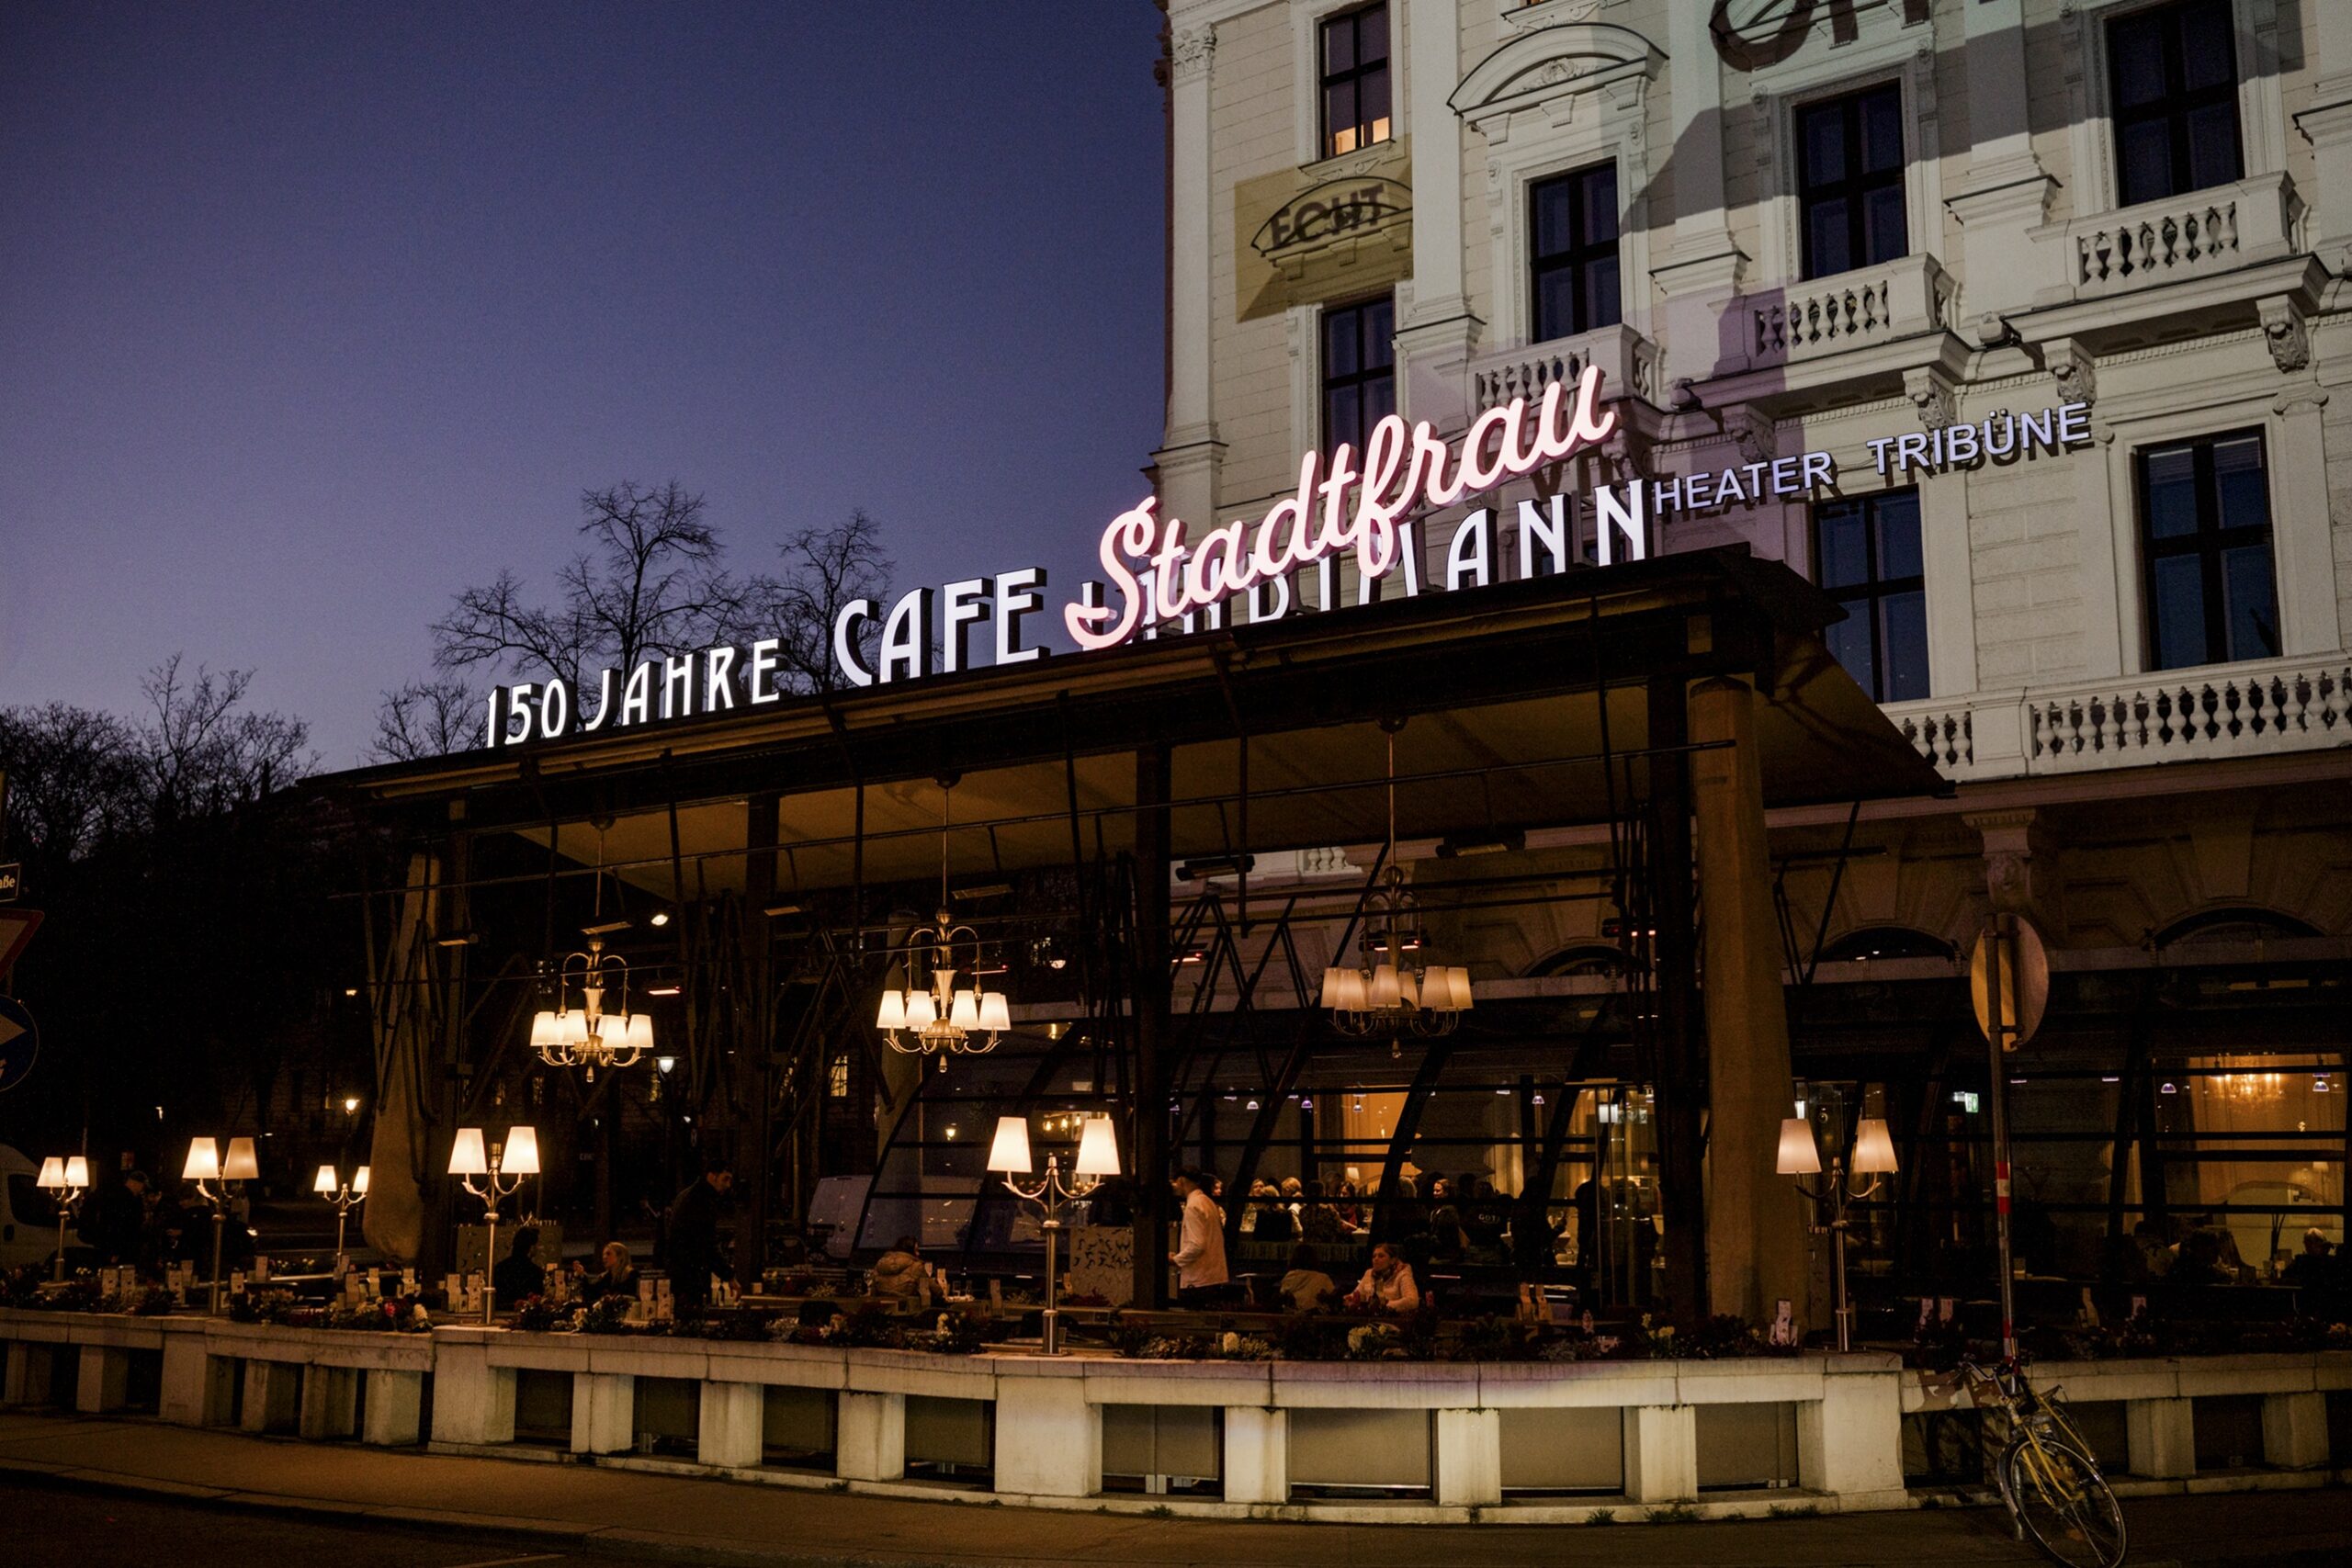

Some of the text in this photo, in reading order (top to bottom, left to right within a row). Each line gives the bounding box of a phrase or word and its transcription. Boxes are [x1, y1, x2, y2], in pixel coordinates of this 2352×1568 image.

[1270, 183, 1385, 248] ECHT
[1064, 365, 1619, 649] Stadtfrau
[1652, 401, 2092, 514] HEATER TRIBÜNE
[487, 678, 571, 748] 150
[585, 638, 783, 731] JAHRE
[834, 567, 1044, 685] CAFE
